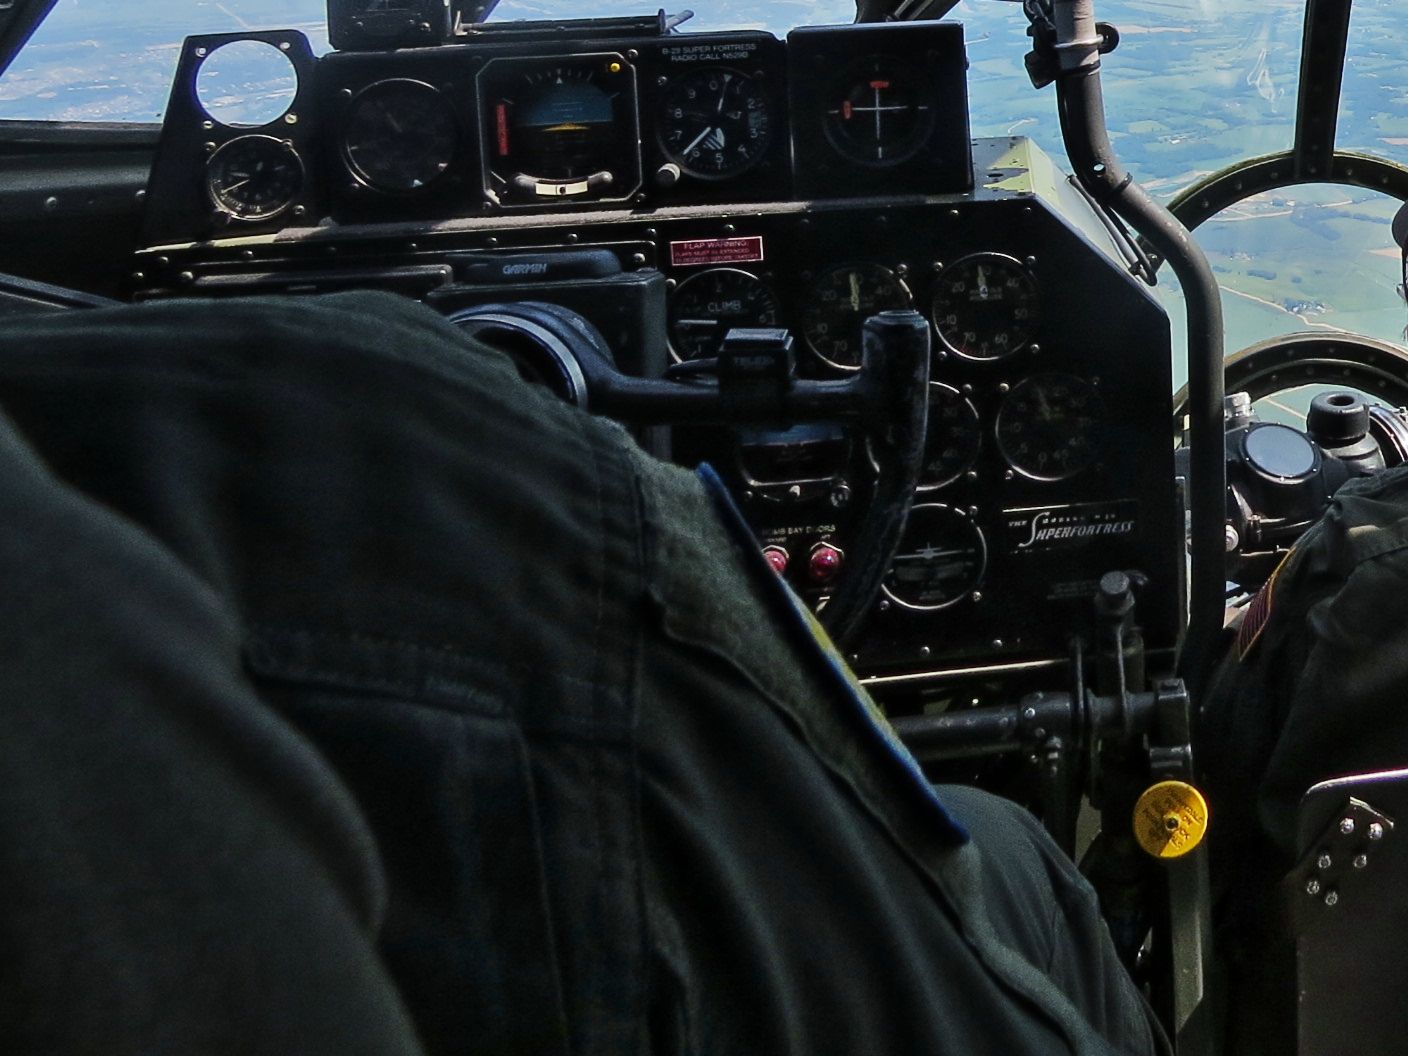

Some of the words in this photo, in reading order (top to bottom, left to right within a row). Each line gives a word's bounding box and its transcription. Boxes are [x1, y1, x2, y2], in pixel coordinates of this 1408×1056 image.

[684, 45, 712, 53] SUPER
[712, 43, 758, 52] FORTRESS
[671, 54, 698, 62] RADIO
[698, 53, 721, 61] CALL
[683, 242, 706, 250] FLAP
[502, 263, 547, 275] GARMIN
[707, 299, 742, 313] CLIMB
[1017, 511, 1136, 548] SUPERFORTRESS
